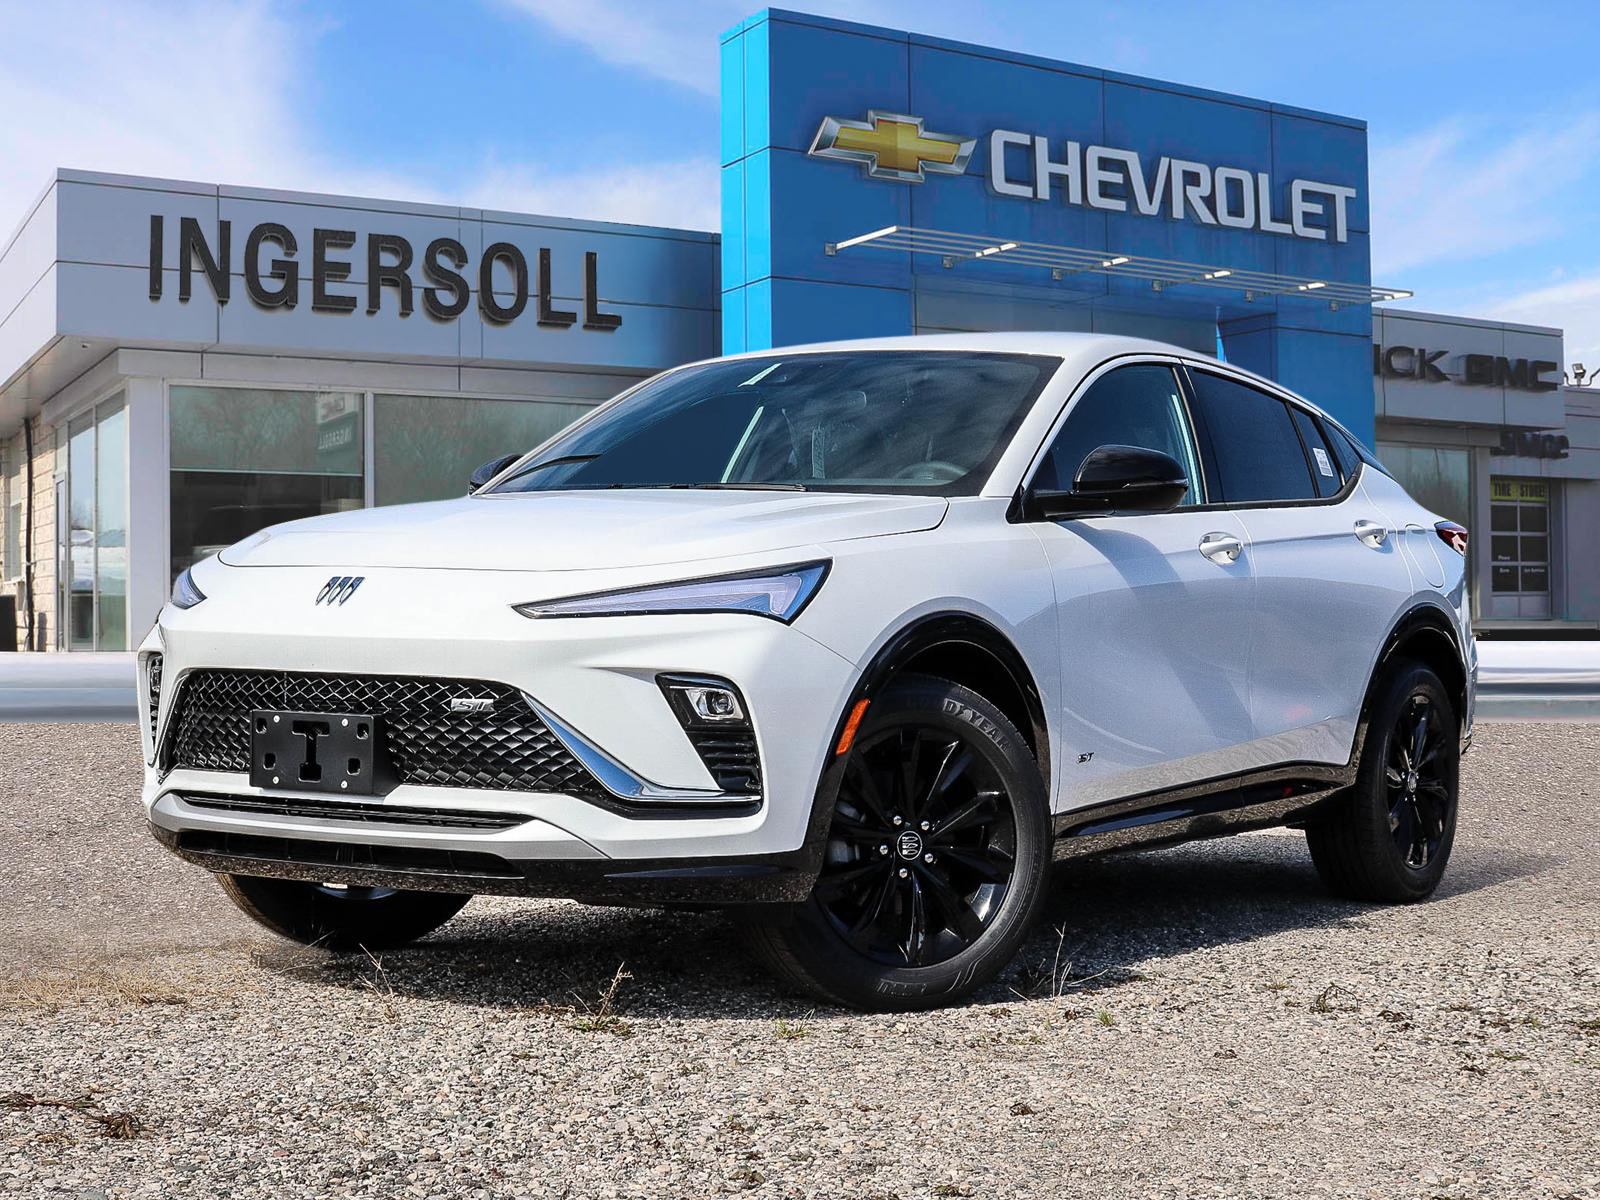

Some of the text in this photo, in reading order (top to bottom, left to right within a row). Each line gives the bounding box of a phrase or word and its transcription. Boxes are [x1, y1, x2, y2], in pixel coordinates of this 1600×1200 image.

[990, 129, 1356, 243] CHEVROLET
[149, 215, 622, 331] INGERSOLL
[1373, 344, 1558, 391] ICK GMC
